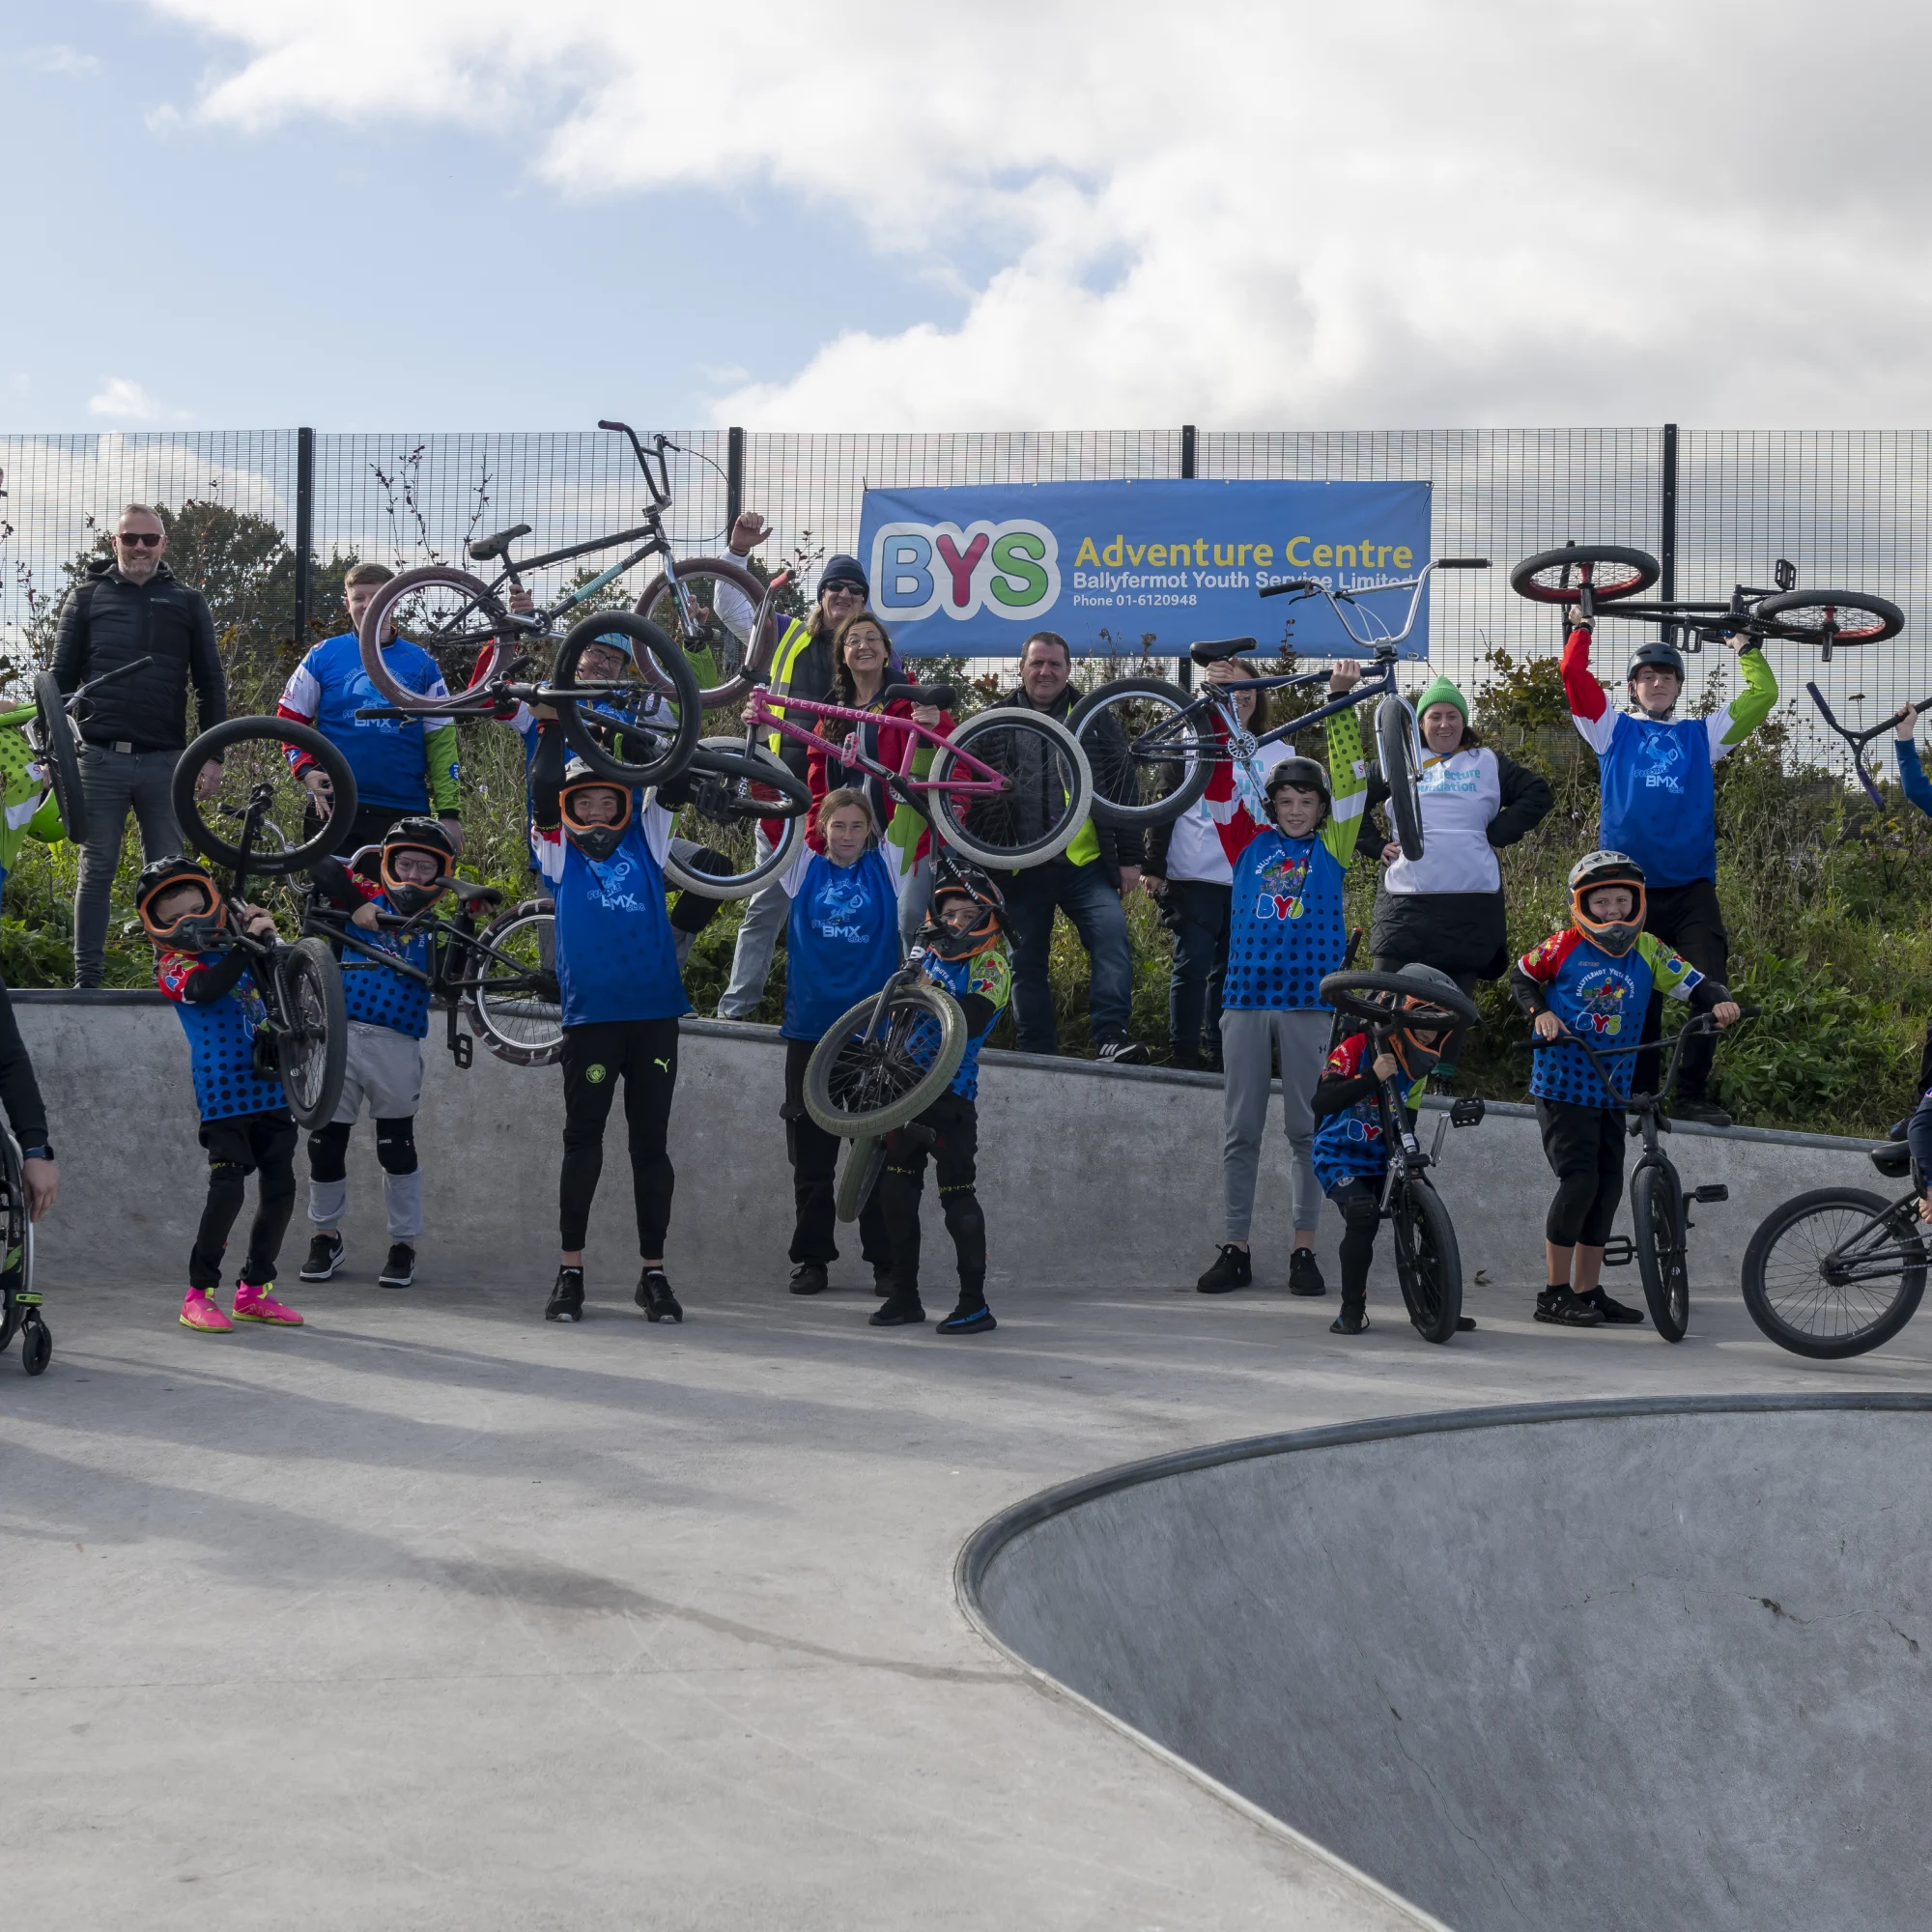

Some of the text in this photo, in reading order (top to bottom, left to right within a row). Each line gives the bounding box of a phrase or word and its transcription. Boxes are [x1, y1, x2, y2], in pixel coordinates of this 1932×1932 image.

[1074, 534, 1413, 569] Adventure Centre
[881, 531, 1049, 608] BYS
[1073, 571, 1188, 592] Ballyfermot
[1192, 570, 1249, 588] Youth
[1255, 571, 1333, 589] Sere
[1073, 594, 1198, 607] Phone 01-6120948
[784, 696, 893, 724] WETHEPEOPLE
[1417, 781, 1477, 793] oundation
[1645, 775, 1679, 787] BMX
[822, 925, 861, 938] BMX
[1575, 1011, 1623, 1036] BYS
[1347, 1118, 1383, 1143] BY
